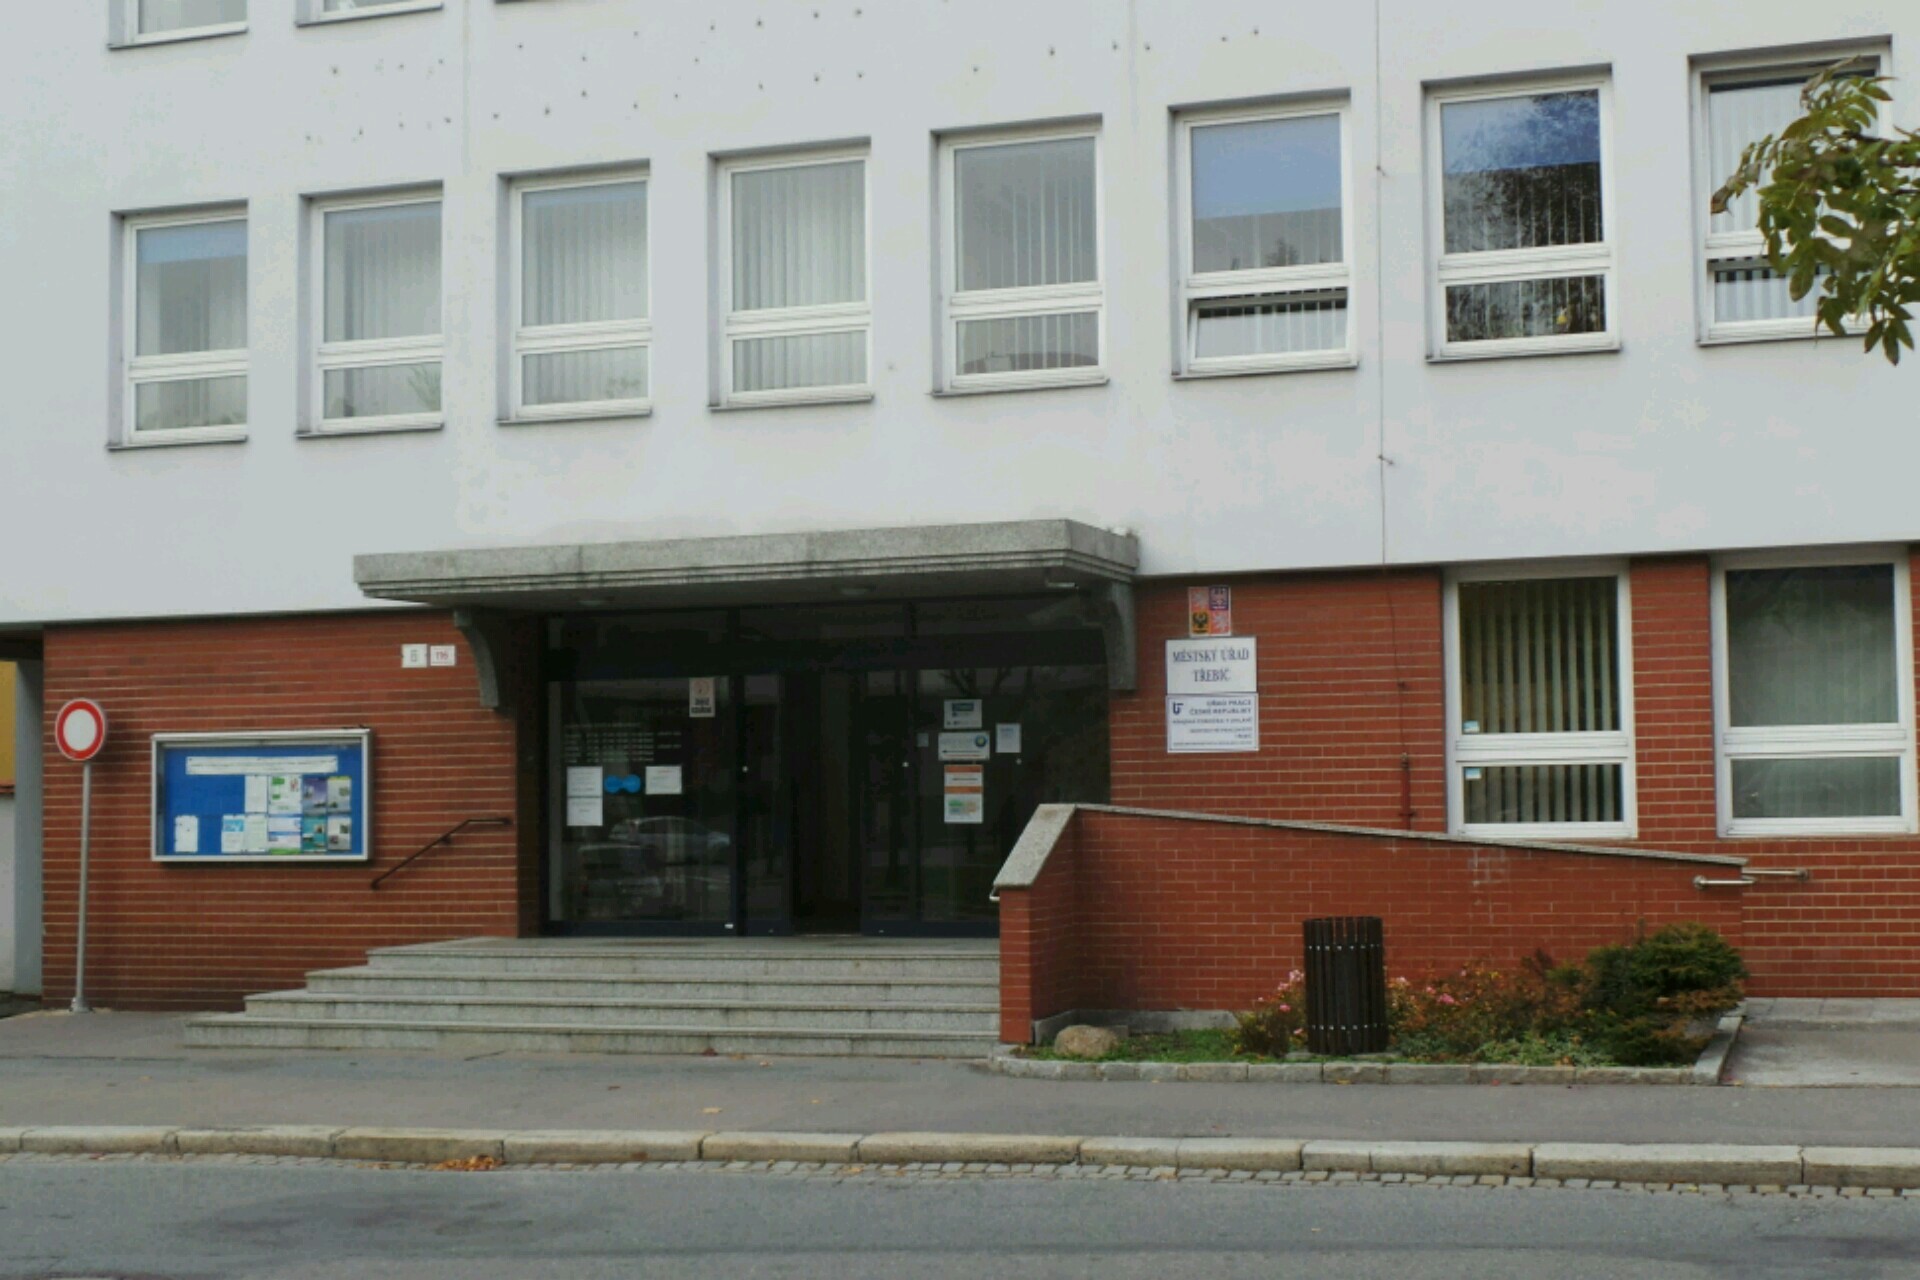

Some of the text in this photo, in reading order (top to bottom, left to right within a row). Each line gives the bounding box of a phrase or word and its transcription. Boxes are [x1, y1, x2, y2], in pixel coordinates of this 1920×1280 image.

[1173, 645, 1249, 662] MĚSTSKÝ ÚŘAD
[1193, 667, 1231, 682] TŘEBÍČ
